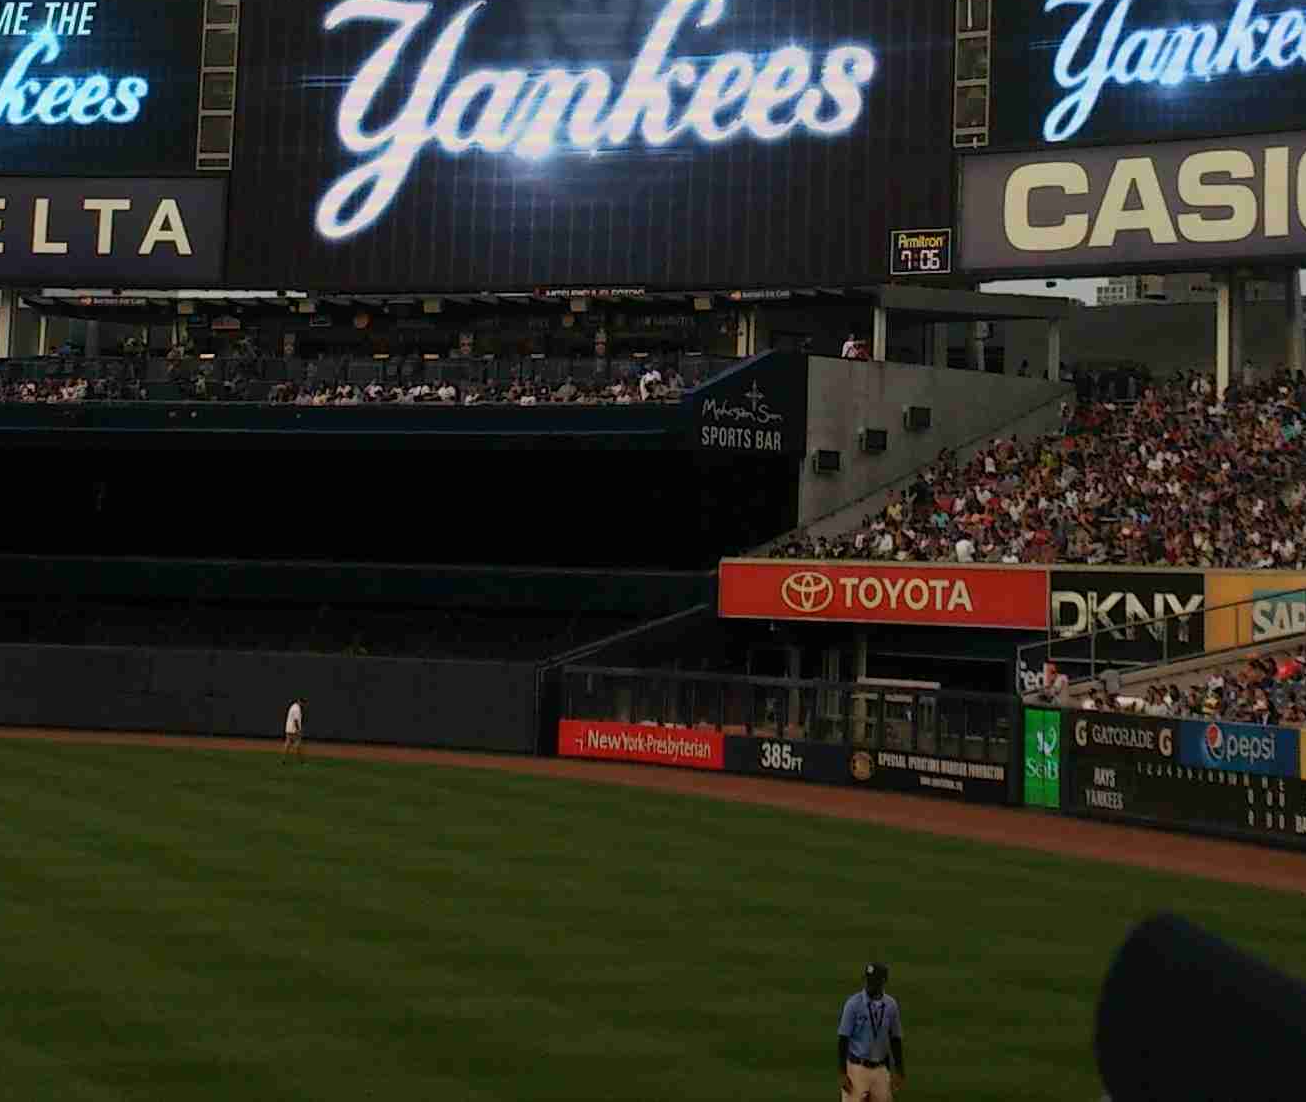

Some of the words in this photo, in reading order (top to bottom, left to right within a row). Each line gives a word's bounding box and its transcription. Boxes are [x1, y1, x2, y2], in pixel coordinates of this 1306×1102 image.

[46, 1, 96, 36] THE
[898, 234, 941, 248] Armitron
[701, 426, 751, 449] SPORTS
[756, 429, 782, 450] BAR
[839, 577, 973, 612] TOYOTA
[1052, 591, 1204, 642] DKNY
[1093, 725, 1157, 748] GATORADE
[1226, 732, 1277, 764] pepsi
[1085, 789, 1125, 810] YANKEES
